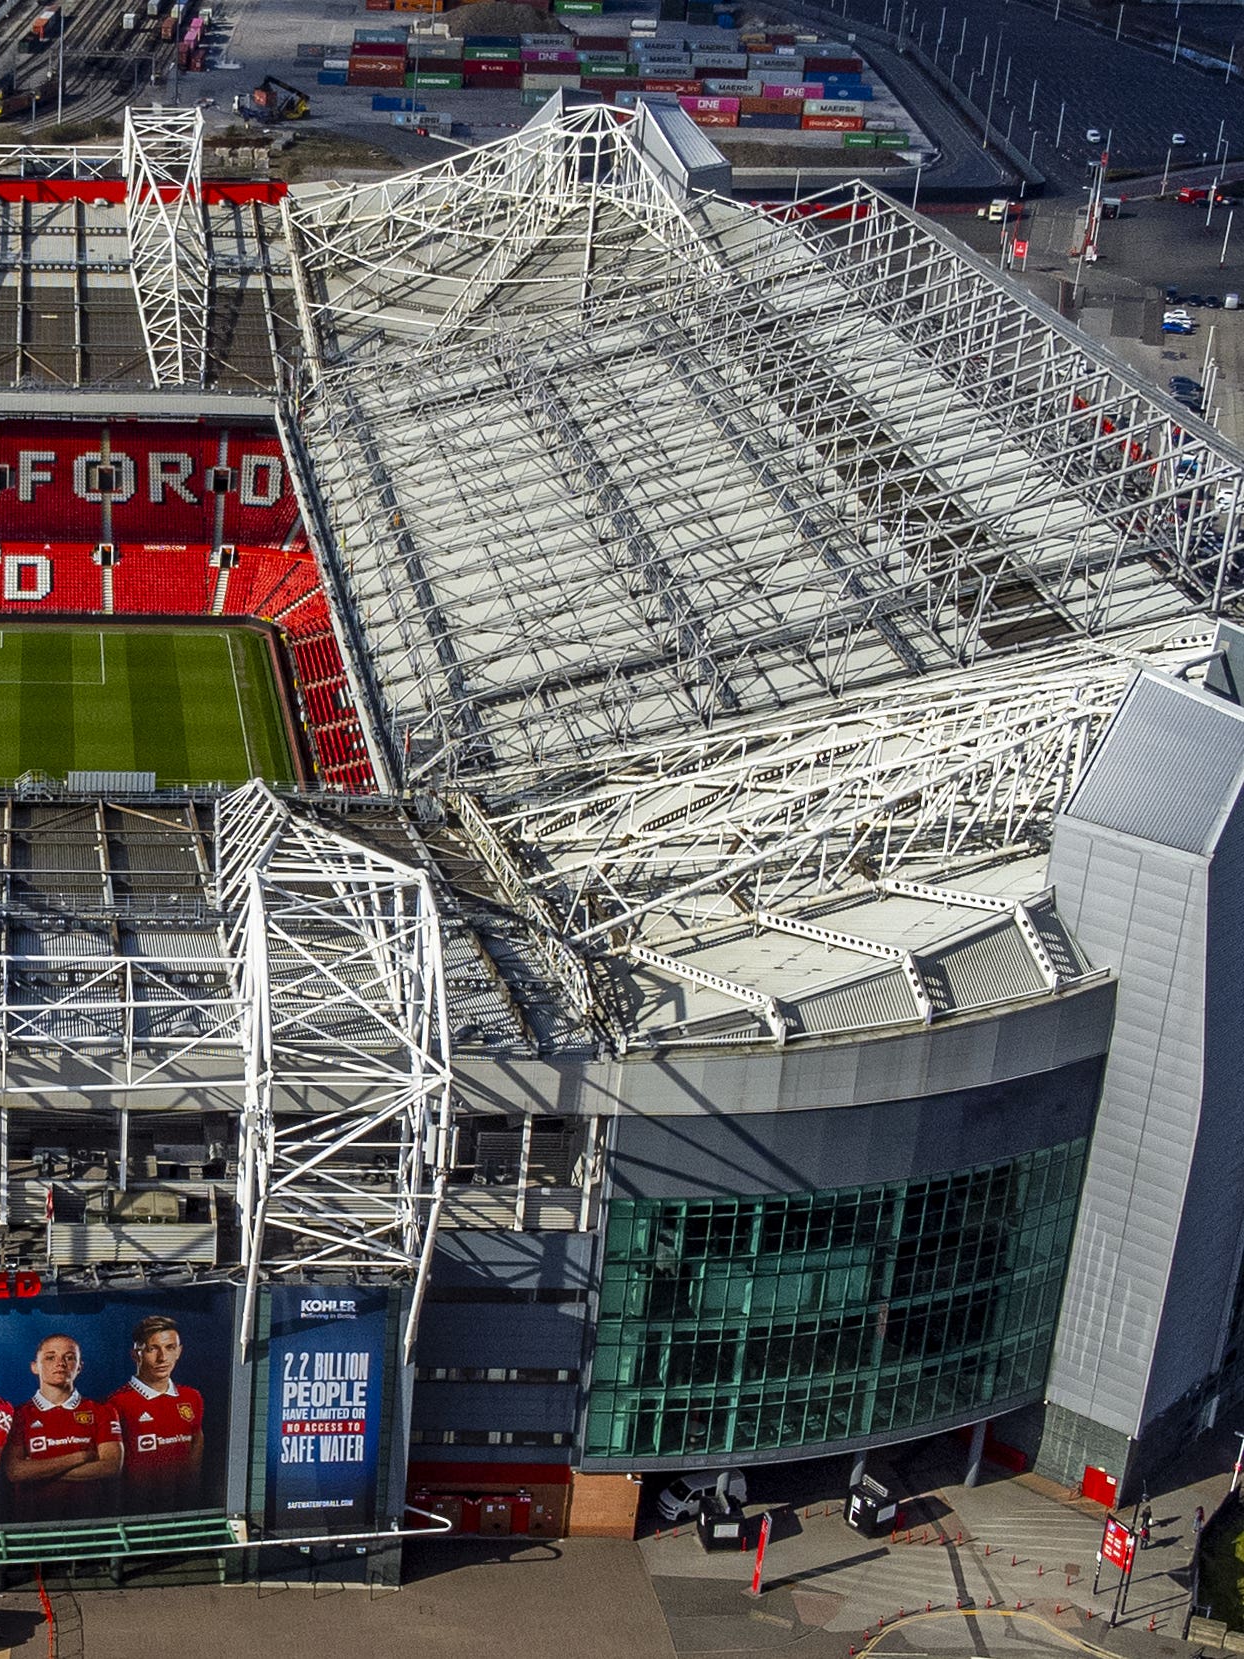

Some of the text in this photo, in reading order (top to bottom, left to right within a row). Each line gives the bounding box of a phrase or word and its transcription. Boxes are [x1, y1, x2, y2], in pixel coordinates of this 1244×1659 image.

[718, 84, 754, 92] MAERSK
[783, 87, 805, 97] ONE
[697, 100, 720, 109] ONE
[820, 105, 856, 113] MAERSK
[283, 1352, 369, 1380] 2.2 BILLION
[282, 1381, 367, 1407] PEOPLE
[282, 1408, 366, 1420] HAVE LIMITED OR
[286, 1421, 361, 1433] NO ACCESS TO
[281, 1434, 364, 1463] SAFE WATER
